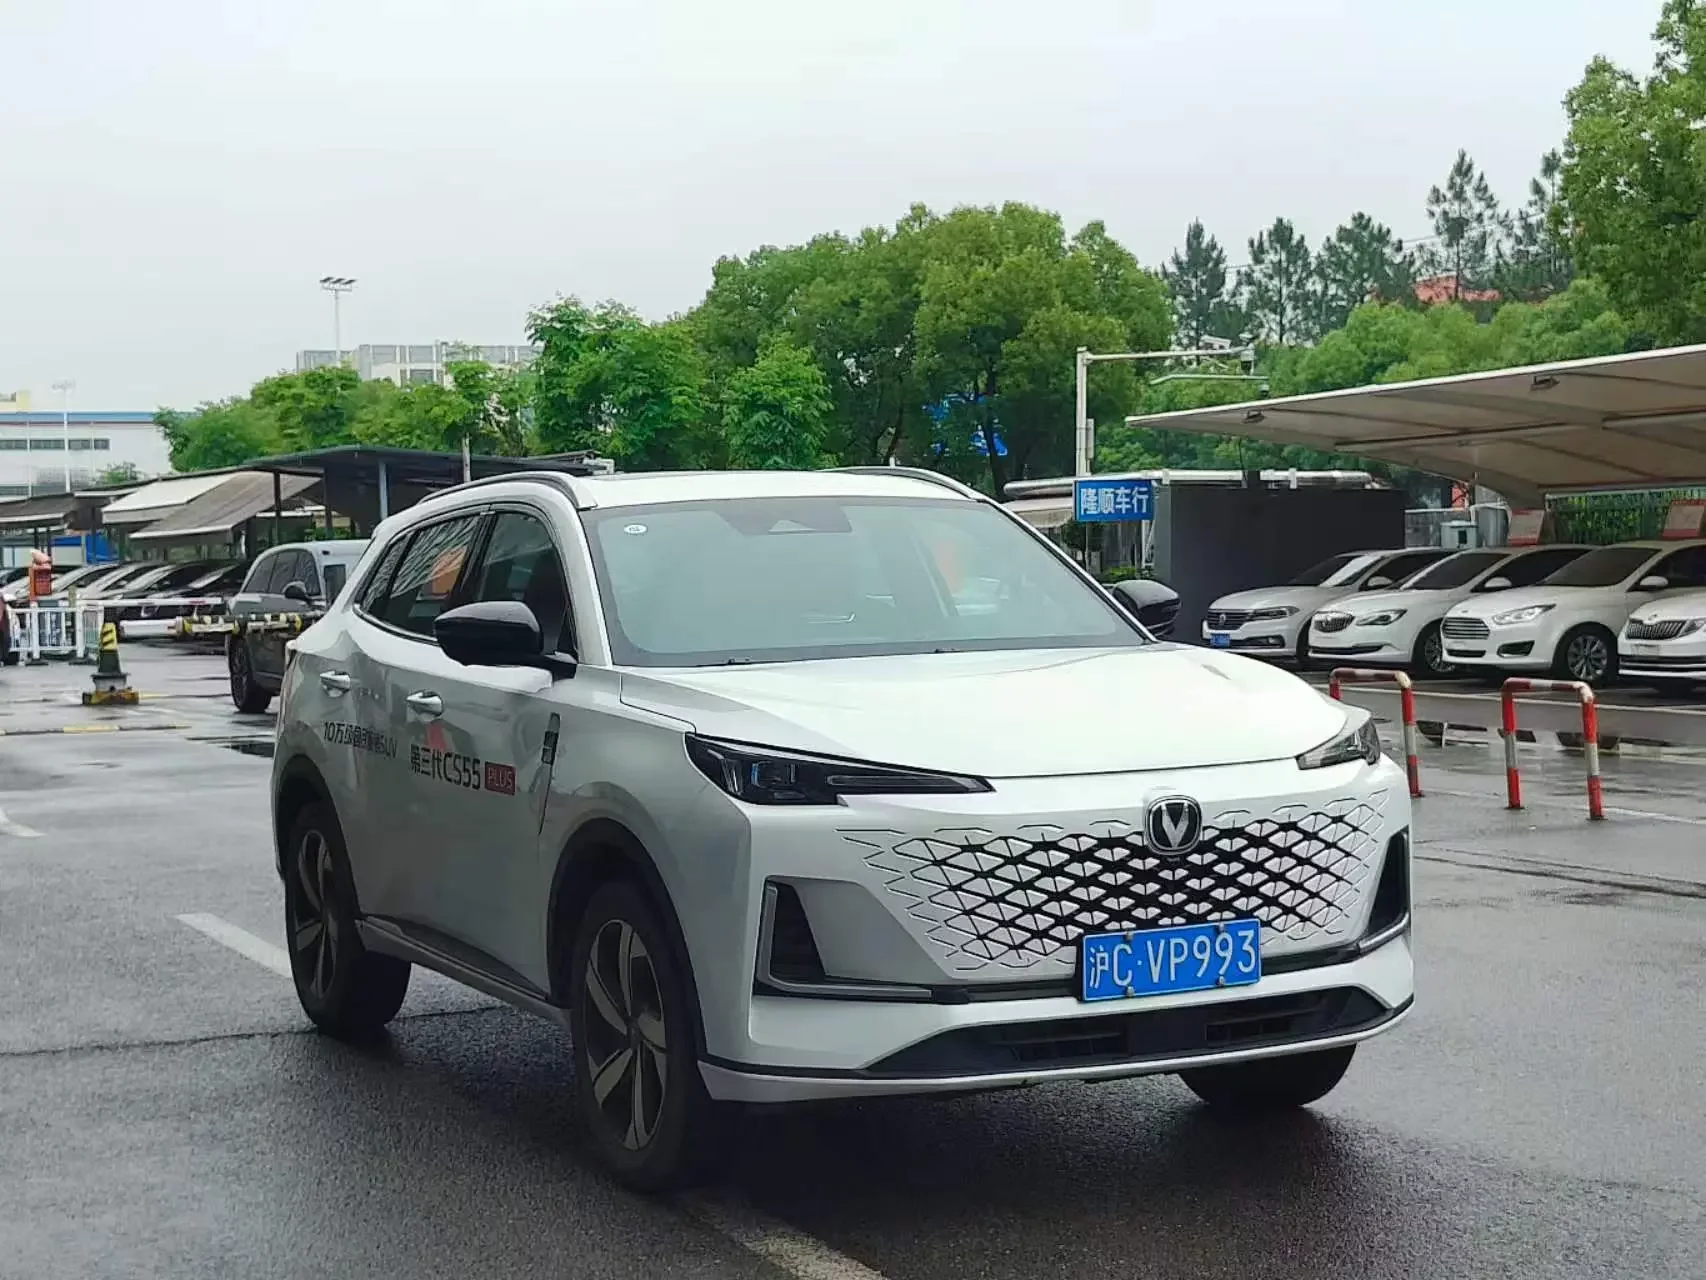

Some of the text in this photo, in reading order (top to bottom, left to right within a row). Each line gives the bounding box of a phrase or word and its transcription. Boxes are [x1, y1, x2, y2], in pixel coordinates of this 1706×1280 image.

[1081, 486, 1148, 515] 隆顺车行
[488, 766, 513, 789] PLUS
